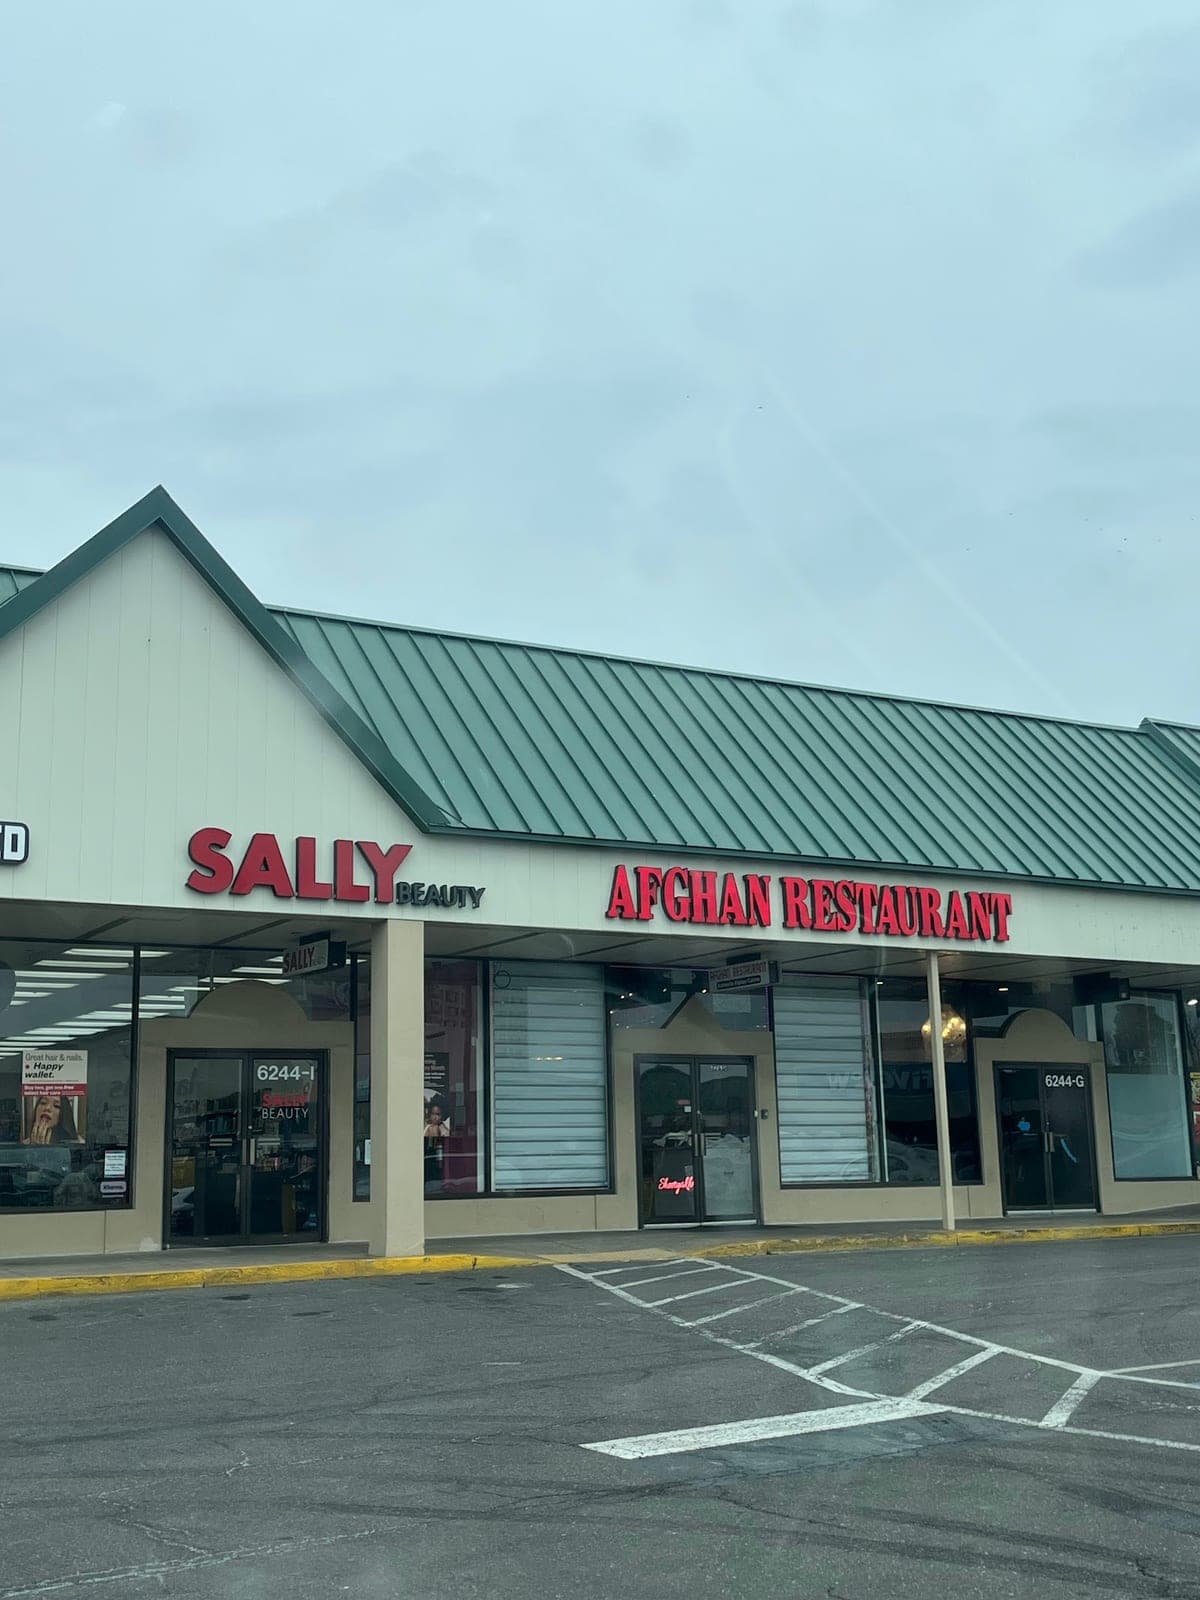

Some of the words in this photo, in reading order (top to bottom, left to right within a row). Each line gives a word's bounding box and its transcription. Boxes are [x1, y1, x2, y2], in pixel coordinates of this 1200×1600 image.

[185, 827, 413, 904] SALLY
[396, 881, 486, 909] BEAUTY
[606, 864, 771, 927] AFGHAN
[781, 876, 1012, 942] RESTAURANT
[283, 946, 315, 973] SALLY
[33, 1062, 64, 1071] Happy
[1045, 1074, 1085, 1088] 6244-G
[262, 1107, 309, 1119] BEAUTY
